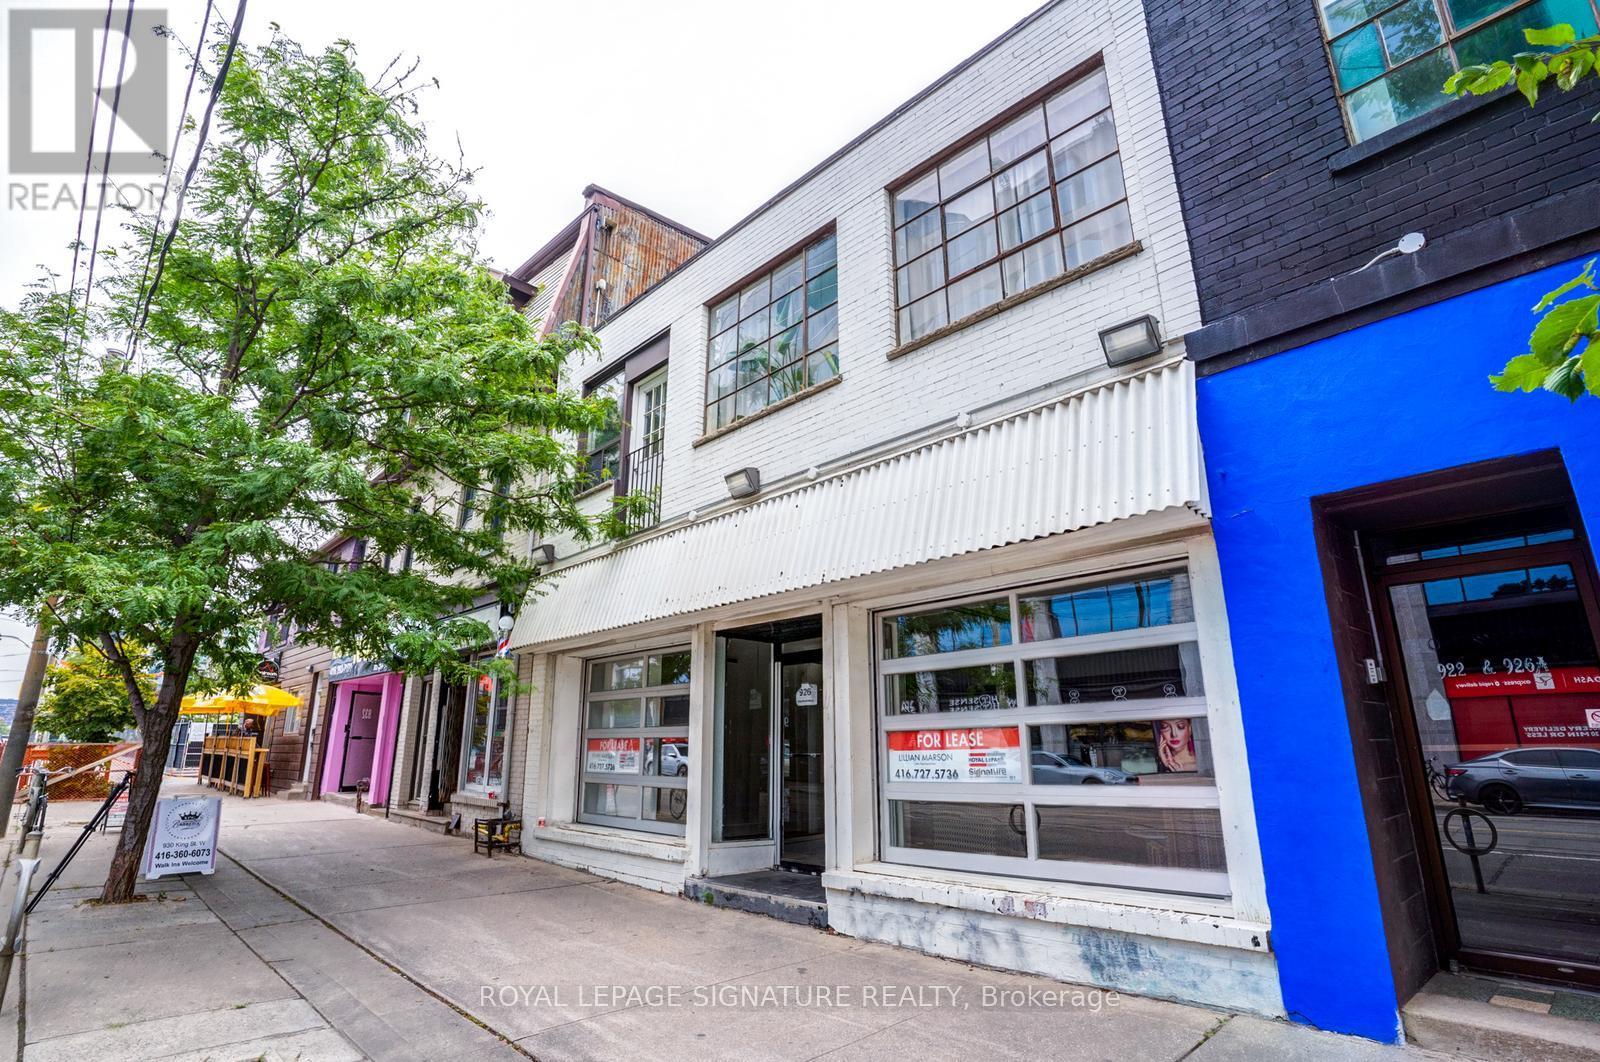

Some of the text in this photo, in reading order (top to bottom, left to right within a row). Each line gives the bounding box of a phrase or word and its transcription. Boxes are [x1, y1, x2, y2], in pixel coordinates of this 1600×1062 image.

[1437, 662, 1467, 679] 922
[1482, 659, 1496, 675] &
[916, 730, 985, 748] FOR LEASE
[921, 752, 953, 762] MARSON
[895, 768, 959, 780] 416.727.5736
[969, 768, 1007, 777] Signature
[155, 849, 210, 860] 416-360-6073
[181, 859, 209, 867] Welcome
